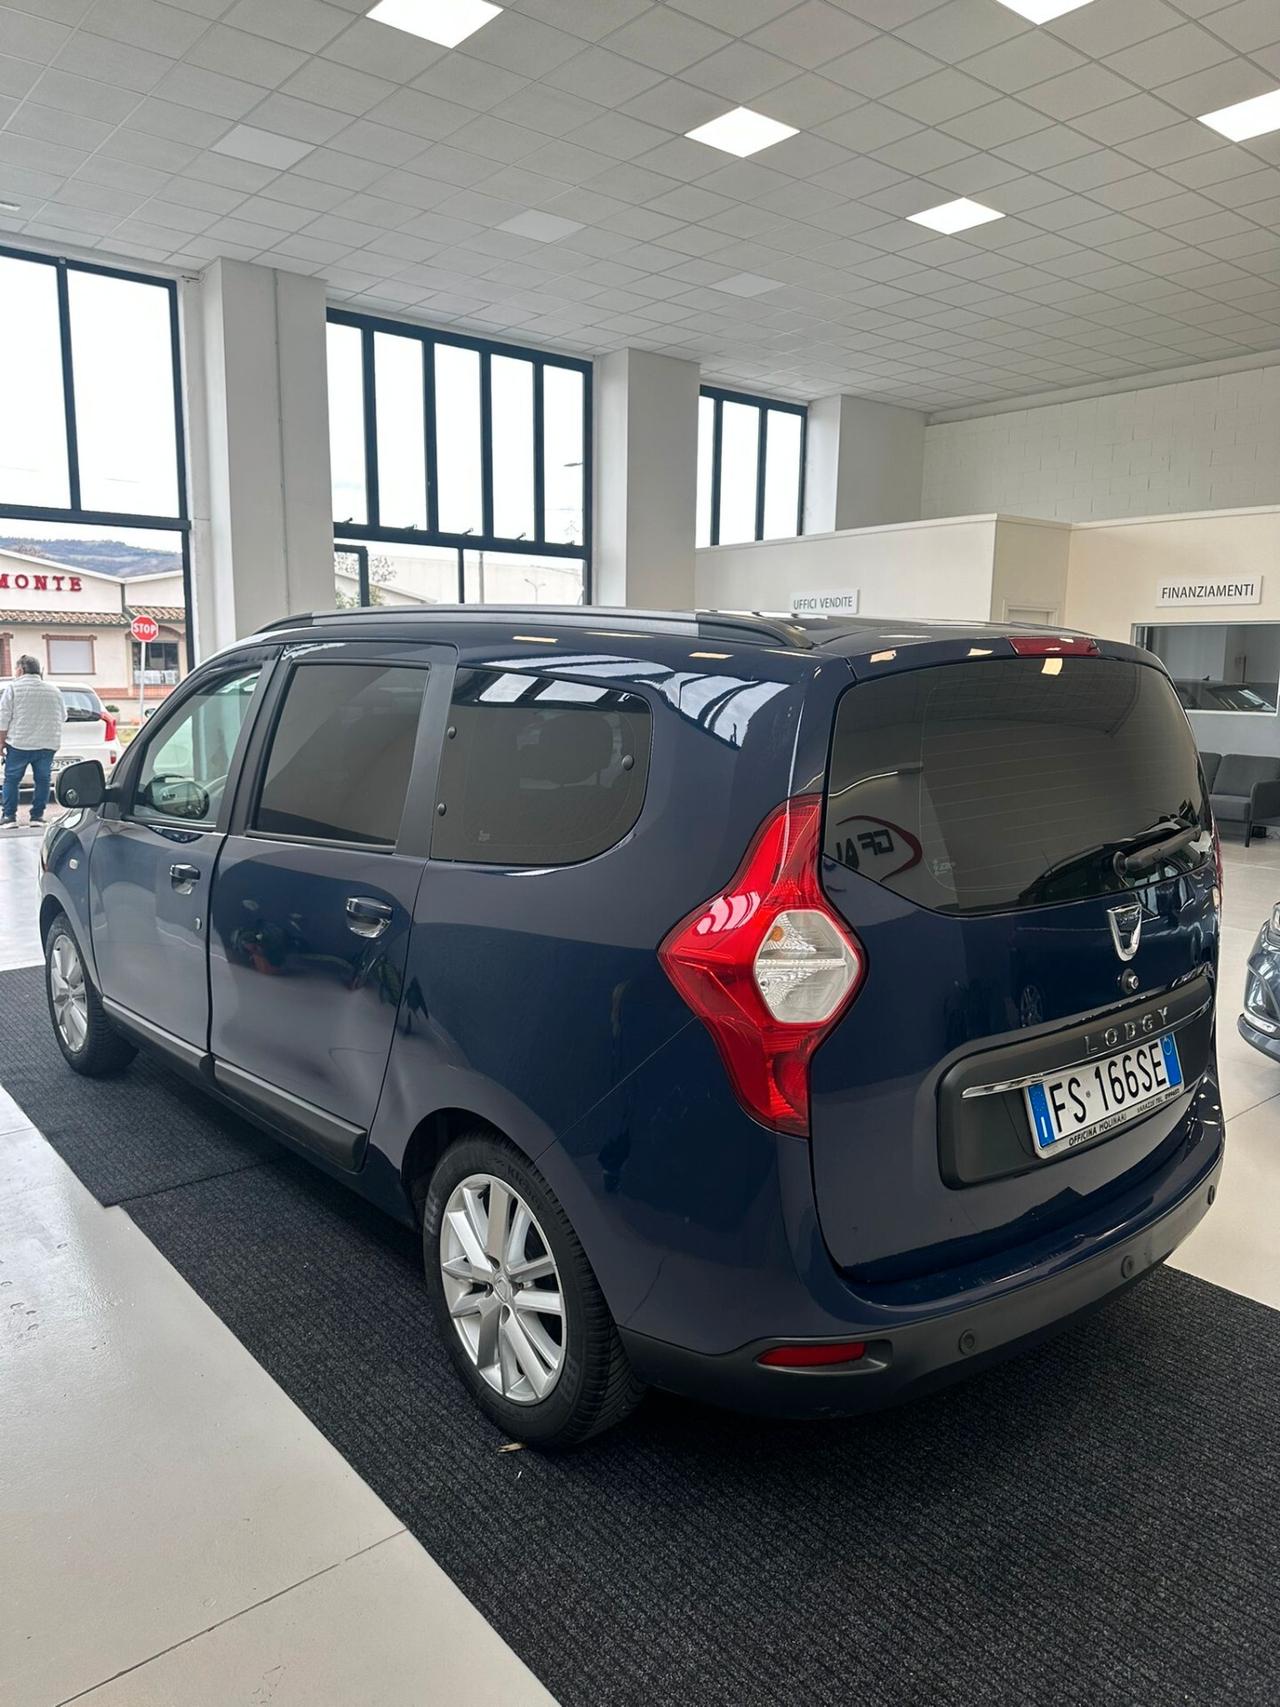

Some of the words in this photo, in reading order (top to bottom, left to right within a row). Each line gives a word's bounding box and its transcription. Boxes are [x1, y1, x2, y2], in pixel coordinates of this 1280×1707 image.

[1161, 583, 1254, 599] FINANZIAMENTI
[793, 598, 817, 610] UFFICI
[820, 596, 853, 608] VENDITE
[133, 622, 157, 635] STOP
[1084, 1006, 1169, 1054] LODGY
[1050, 1077, 1087, 1132] FS
[1094, 1042, 1167, 1111] 166SE
[1069, 1126, 1097, 1146] OFFICINA
